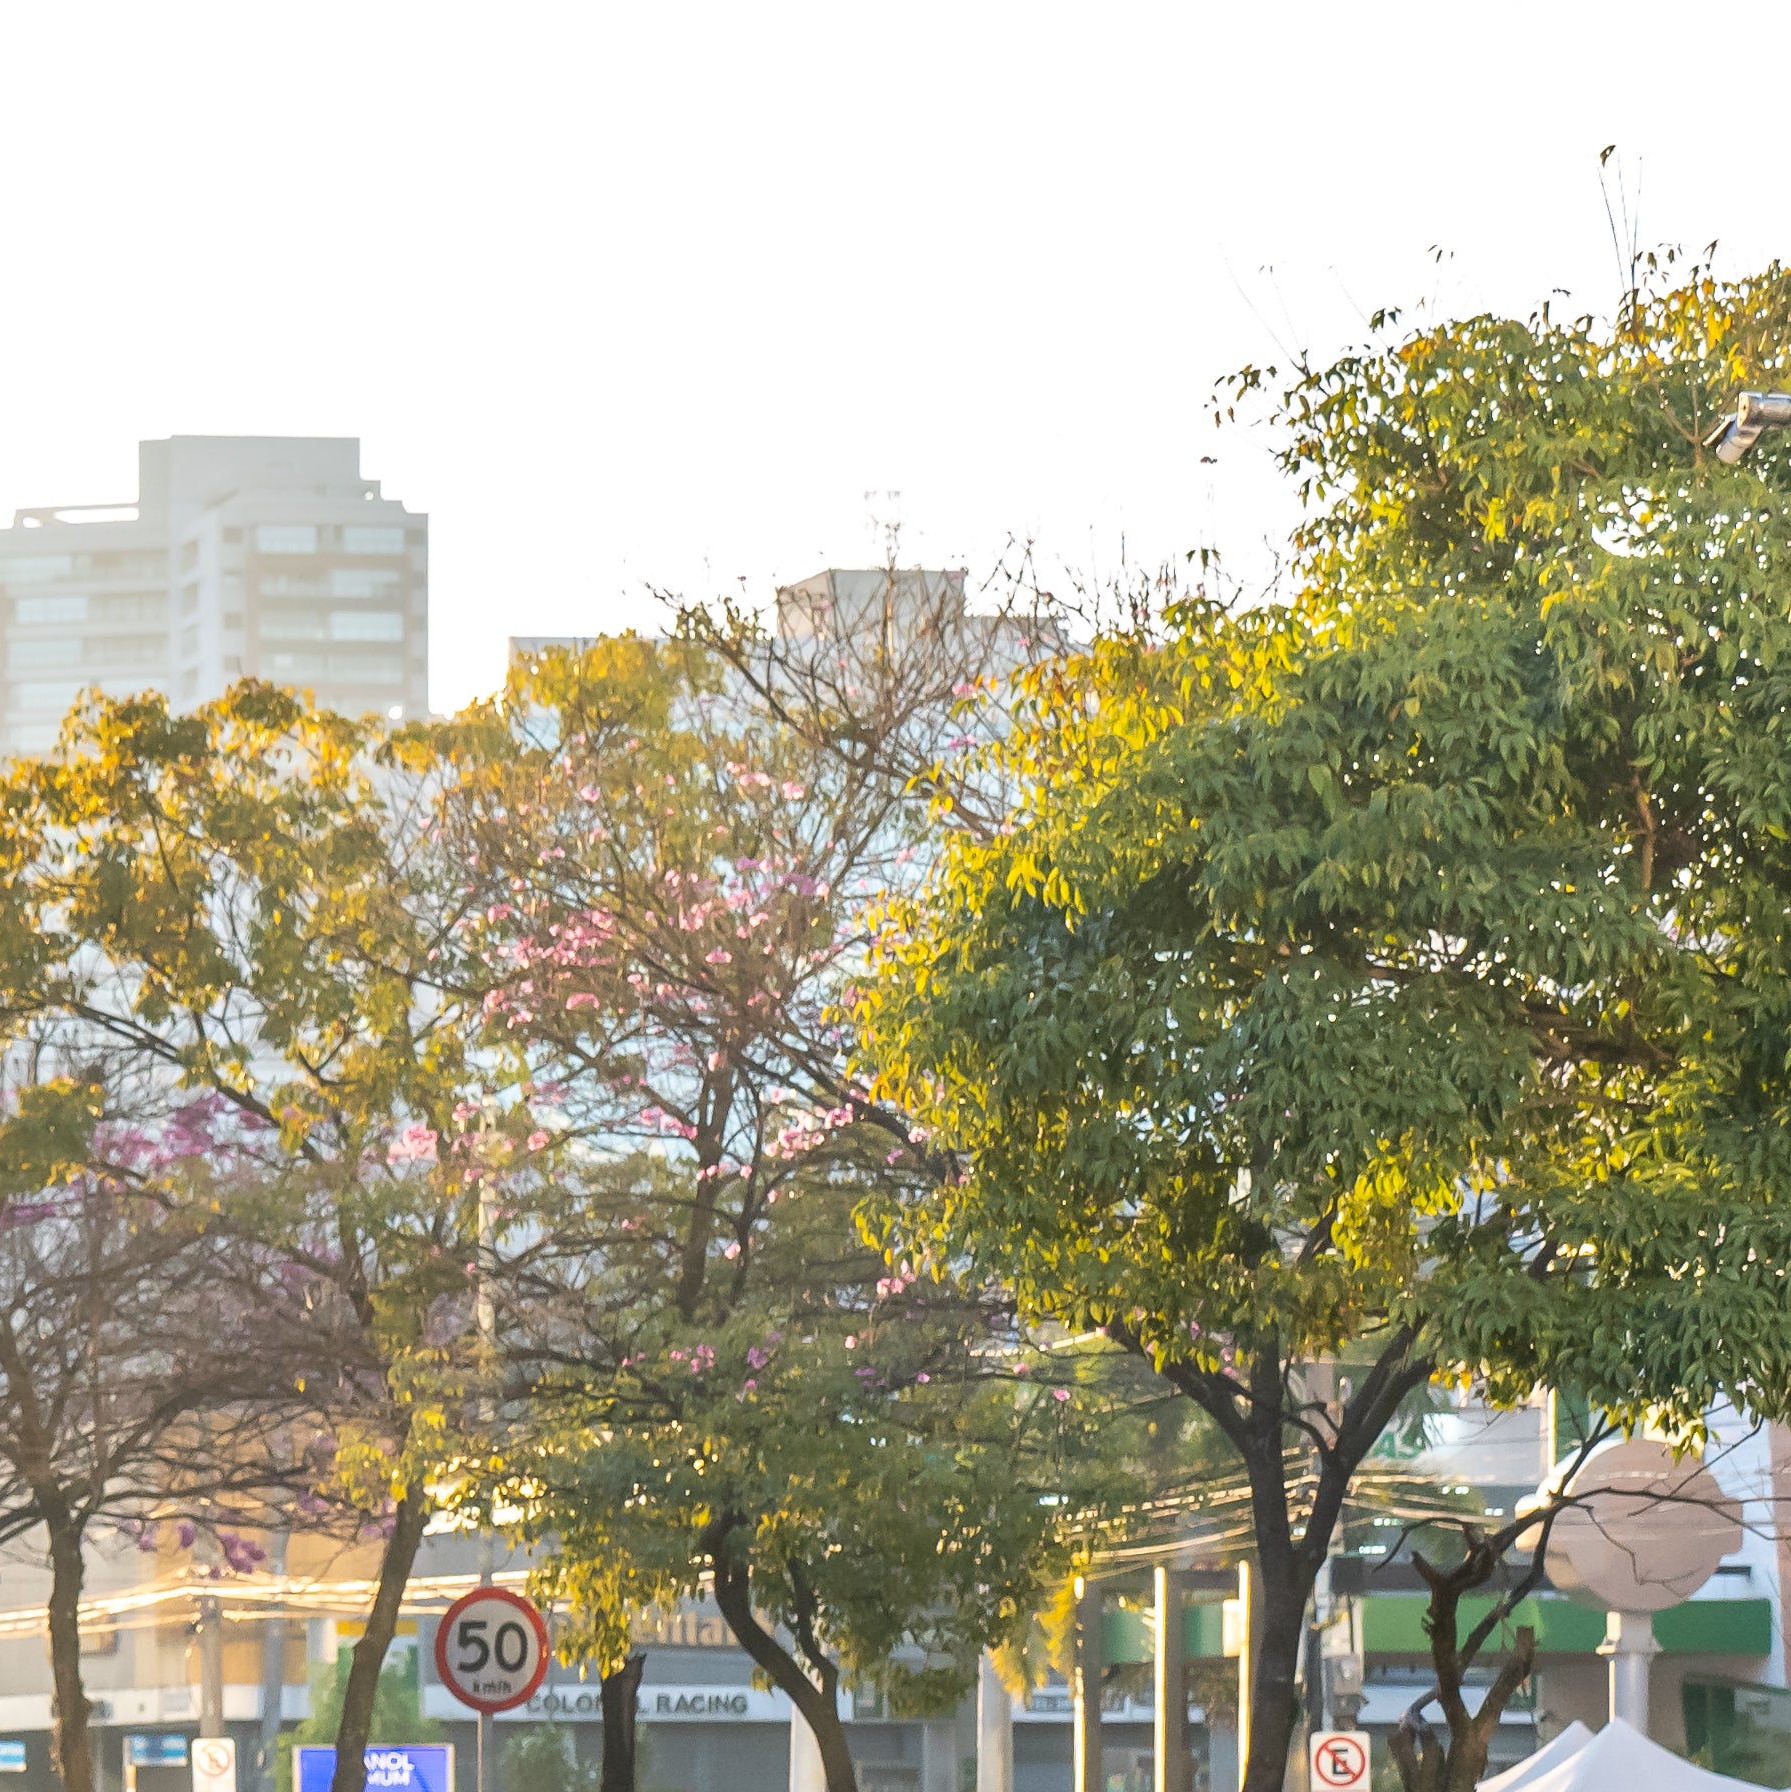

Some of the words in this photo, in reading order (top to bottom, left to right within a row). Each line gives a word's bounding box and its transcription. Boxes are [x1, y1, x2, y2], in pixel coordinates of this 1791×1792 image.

[457, 1620, 529, 1674] 50
[473, 1680, 512, 1695] km/h
[656, 1692, 749, 1715] RACING
[1332, 1748, 1350, 1776] E
